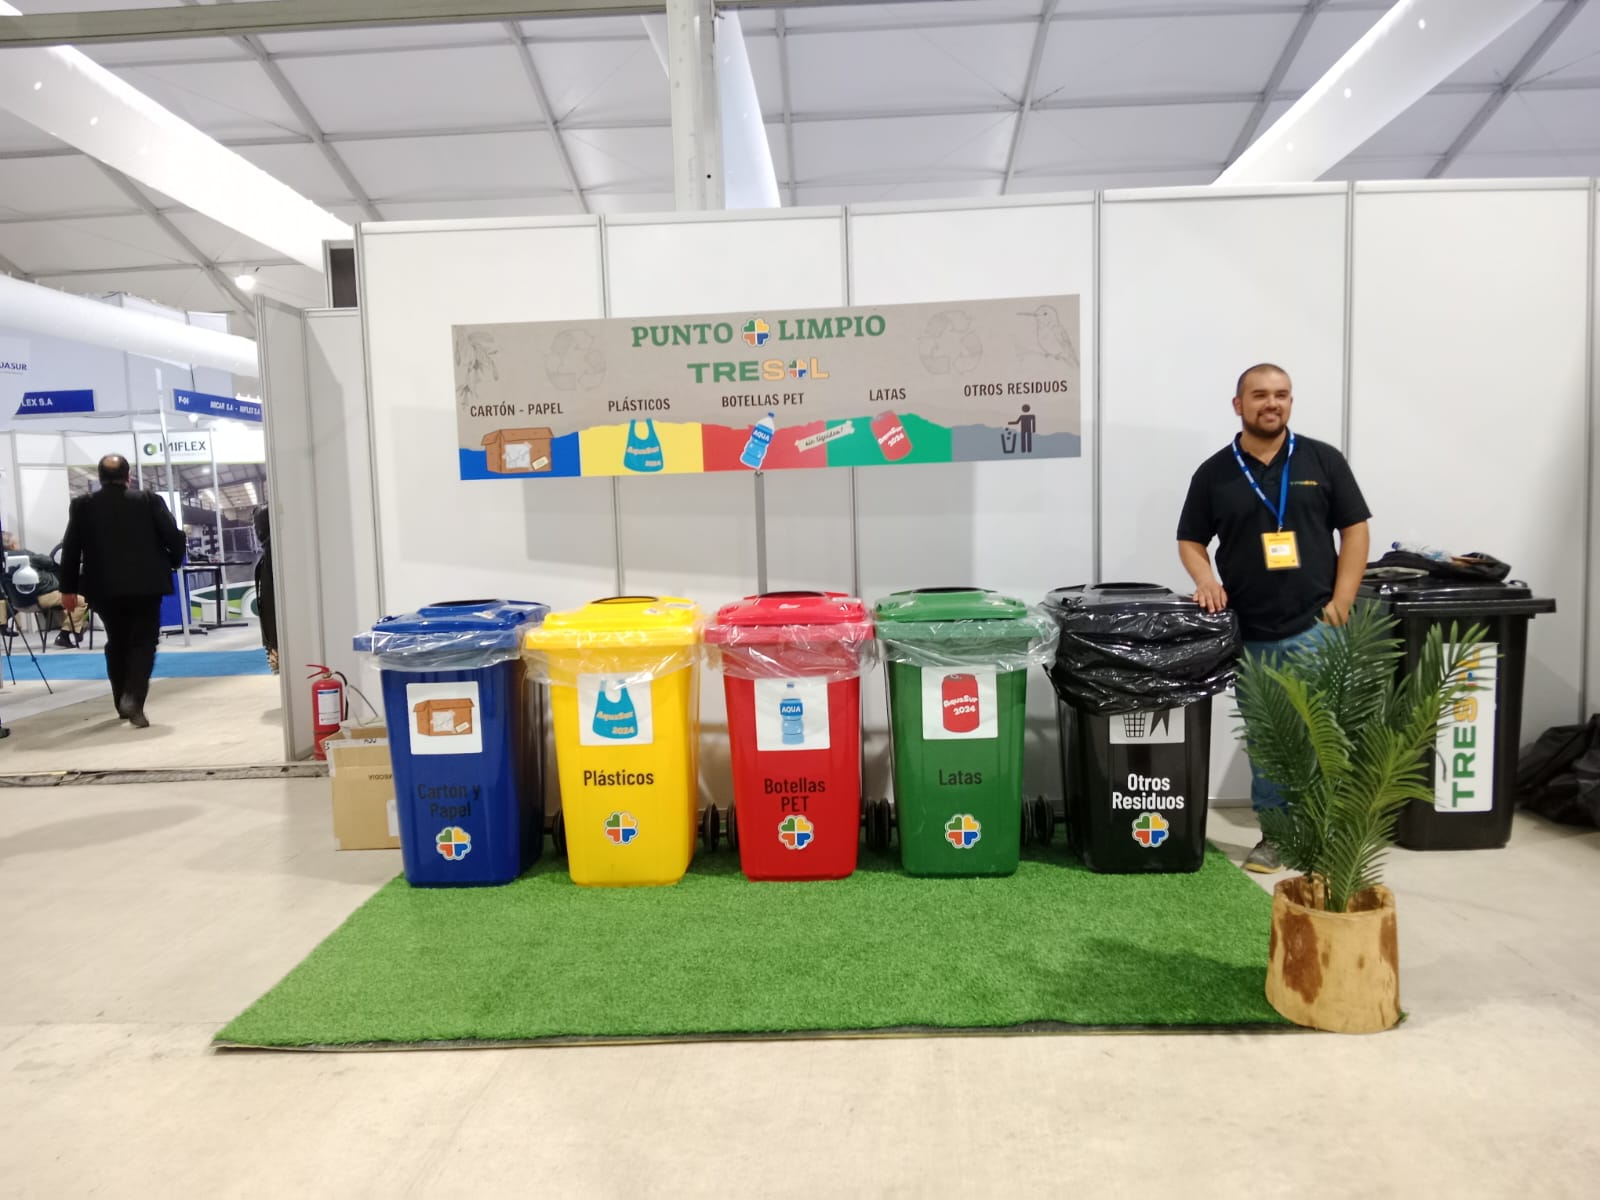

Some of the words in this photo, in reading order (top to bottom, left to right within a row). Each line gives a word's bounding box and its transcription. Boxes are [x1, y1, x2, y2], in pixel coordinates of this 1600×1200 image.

[631, 322, 733, 348] PUNTO
[778, 315, 886, 341] LIMPIO
[869, 388, 907, 402] LATAS
[964, 383, 1004, 397] OTROS
[1007, 380, 1068, 395] RESIDUOS
[608, 396, 671, 412] PLÁSTICOS
[721, 393, 779, 408] BOTELLAS
[783, 392, 805, 405] PET
[470, 401, 515, 417] CARTÓN
[528, 403, 564, 416] PAPEL
[752, 429, 770, 442] AQUA
[781, 705, 801, 714] AQUA
[583, 769, 654, 786] Plásticos
[939, 769, 982, 786] Latas
[1127, 773, 1170, 792] Otros
[472, 784, 481, 800] y
[764, 778, 826, 795] Botellas
[781, 796, 809, 813] PET
[1112, 792, 1185, 810] Residuos
[429, 802, 471, 821] Papel
